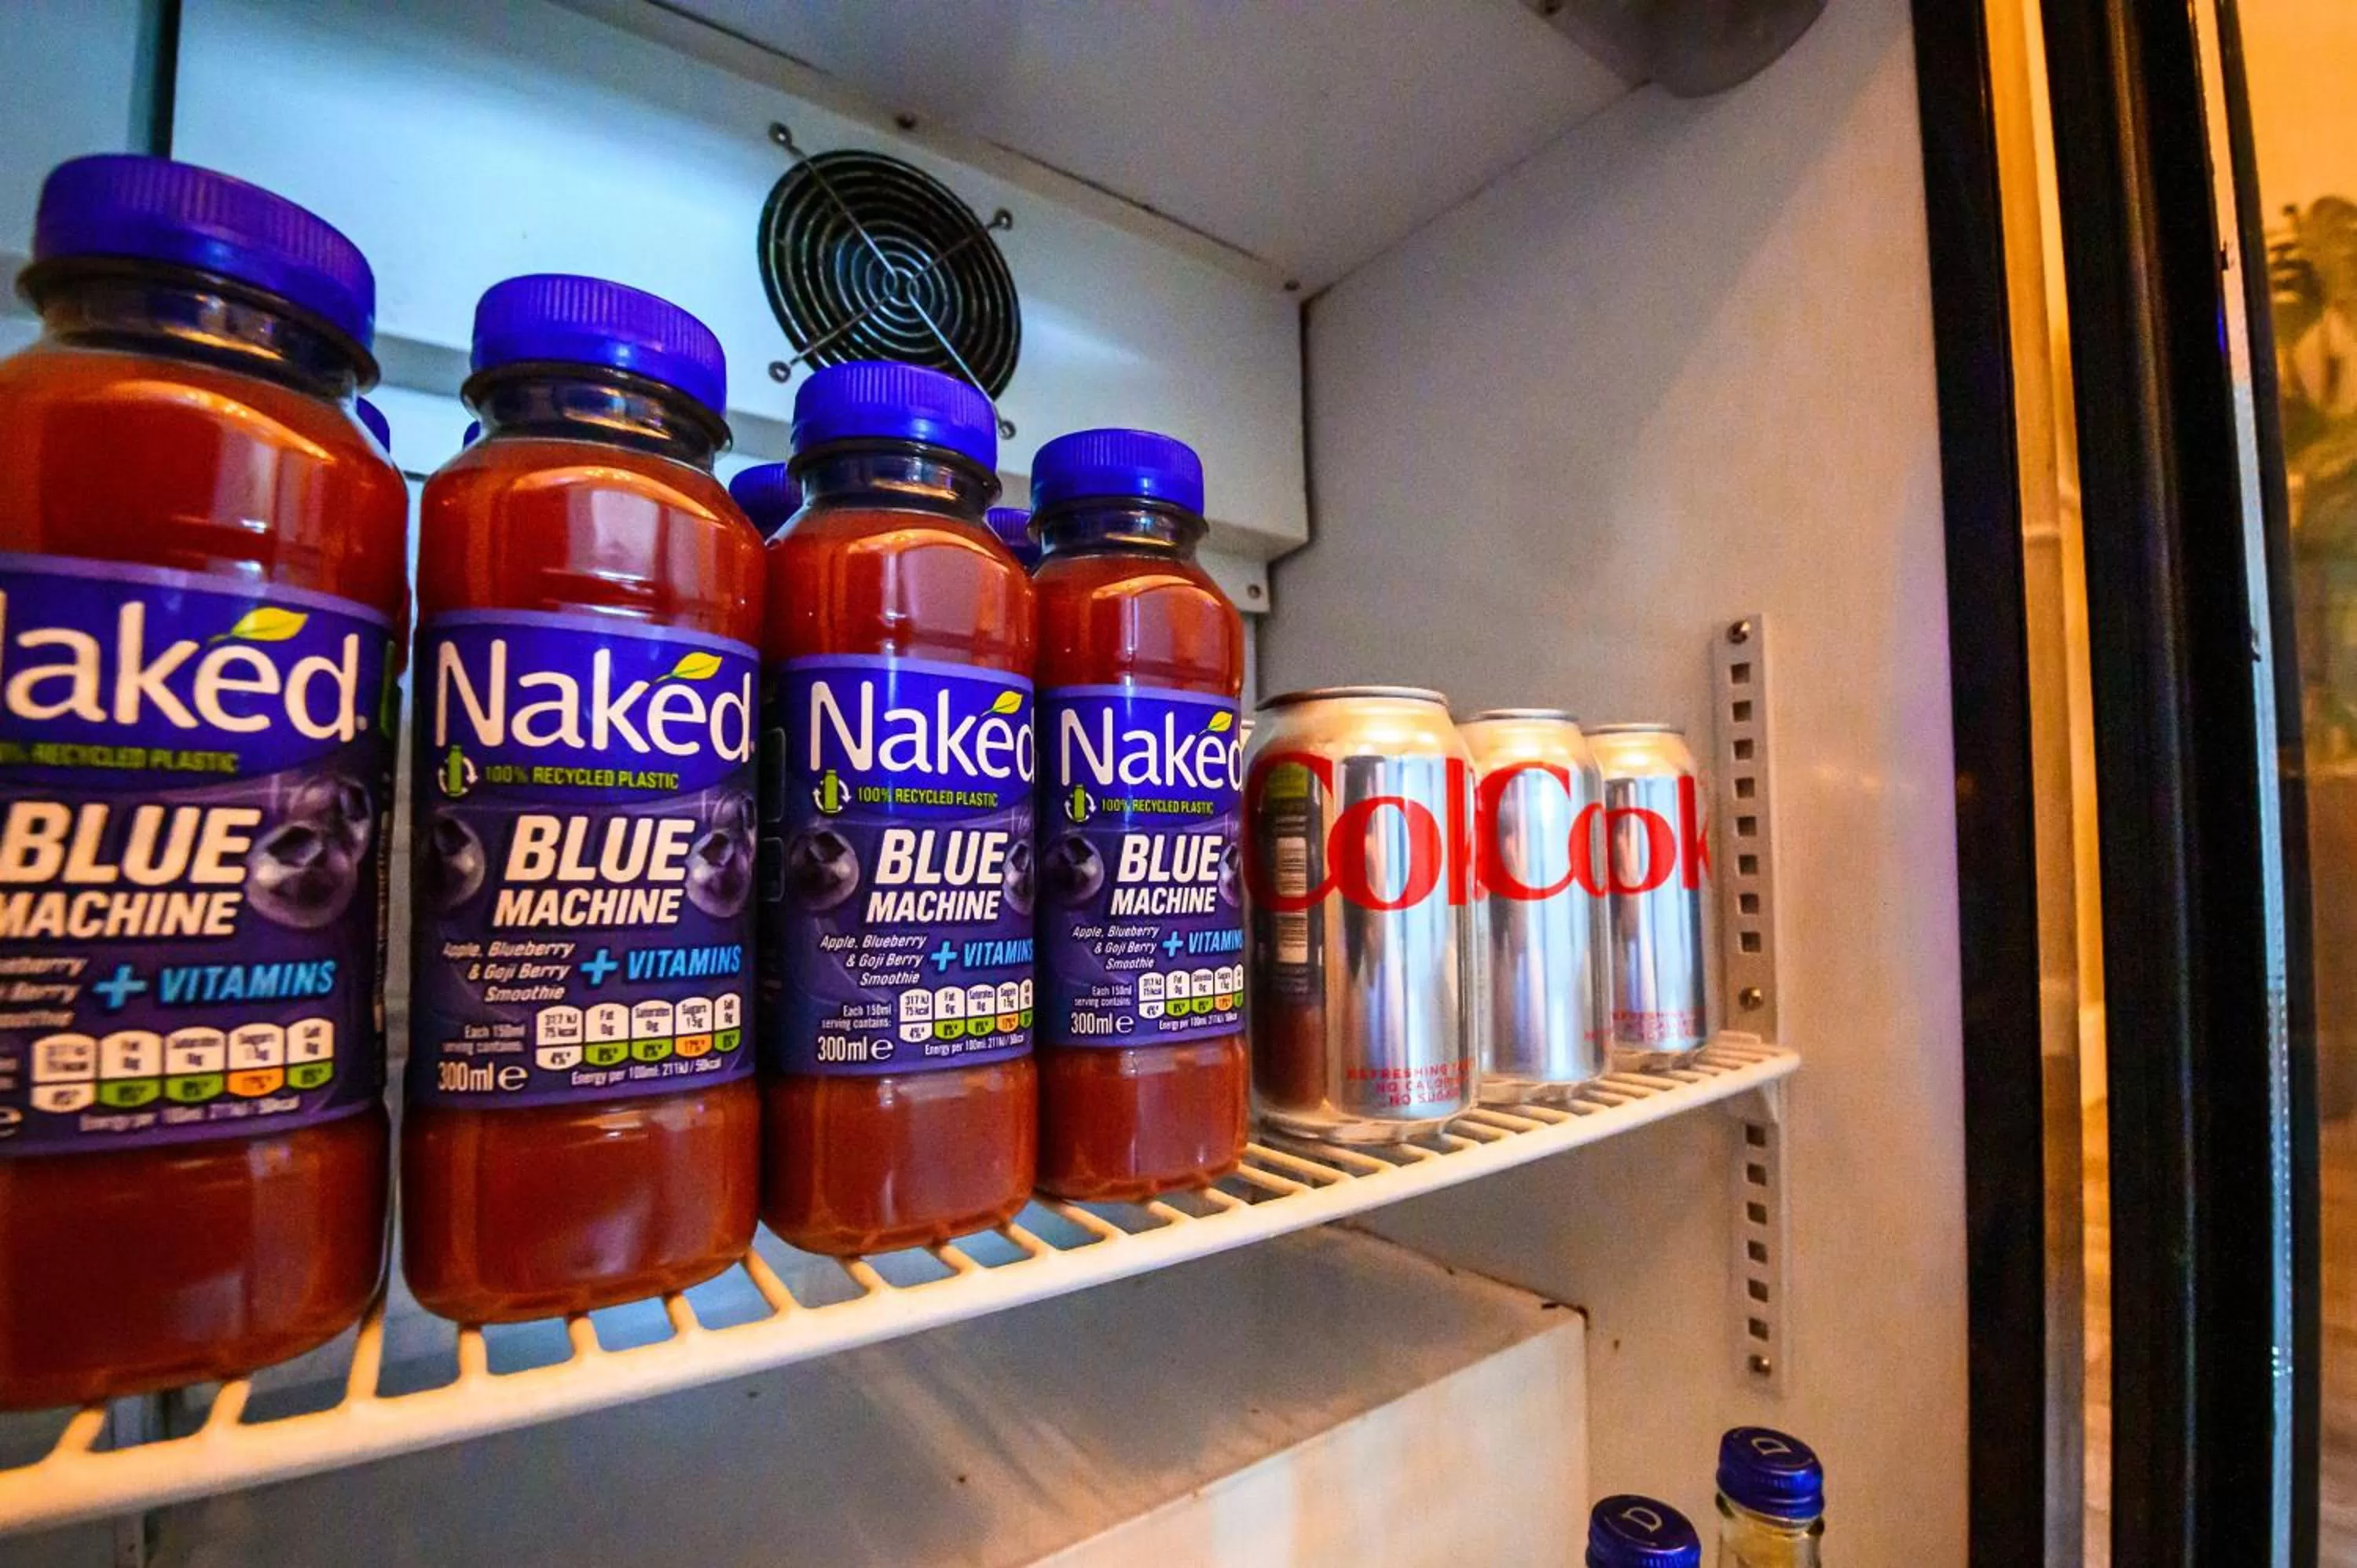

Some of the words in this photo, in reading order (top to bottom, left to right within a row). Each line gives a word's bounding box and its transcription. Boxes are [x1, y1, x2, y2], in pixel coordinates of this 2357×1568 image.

[0, 588, 359, 742] aked
[435, 639, 751, 763] Naked
[810, 681, 1034, 784] Naked
[485, 765, 527, 783] 100%
[533, 767, 613, 786] RECYCLED
[618, 771, 679, 790] PLASTIC
[858, 787, 891, 803] 100%
[896, 789, 953, 805] RECYCLED
[956, 791, 999, 808] PLASTIC
[1131, 799, 1179, 813] RECYCLED
[1181, 800, 1214, 814] PLASTIC
[0, 800, 262, 885] BLUE
[504, 815, 695, 883] BLUE
[875, 829, 1008, 885] BLUE
[1117, 834, 1223, 883] BLUE
[493, 888, 684, 927] MACHINE
[866, 890, 1002, 923] MACHINE
[1111, 887, 1217, 915] MACHINE
[1108, 925, 1160, 939] Blueberry
[487, 940, 576, 958] Blueberry
[863, 934, 928, 951] Blueberry
[1094, 942, 1102, 954] &
[1105, 942, 1126, 956] Goji
[1127, 942, 1157, 954] Berry
[628, 945, 742, 980] VITAMINS
[845, 954, 856, 967] &
[859, 953, 885, 969] Goji
[886, 954, 924, 968] Berry
[1105, 958, 1155, 970] Smoothie
[161, 960, 337, 1003] VITAMINS
[483, 962, 517, 982] Goji
[518, 963, 571, 980] Berry
[860, 972, 920, 987] Smoothie
[484, 986, 566, 1002] Smoothie
[1092, 986, 1109, 996] Each
[843, 1005, 863, 1017] Each
[866, 1003, 892, 1016] 150ml
[1071, 1012, 1113, 1035] 300ml
[817, 1035, 867, 1061] 300ml
[925, 1043, 949, 1057] Energy
[951, 1042, 963, 1053] per
[571, 1069, 607, 1086] Energy
[1376, 1081, 1398, 1094] NO
[1390, 1094, 1411, 1107] NO
